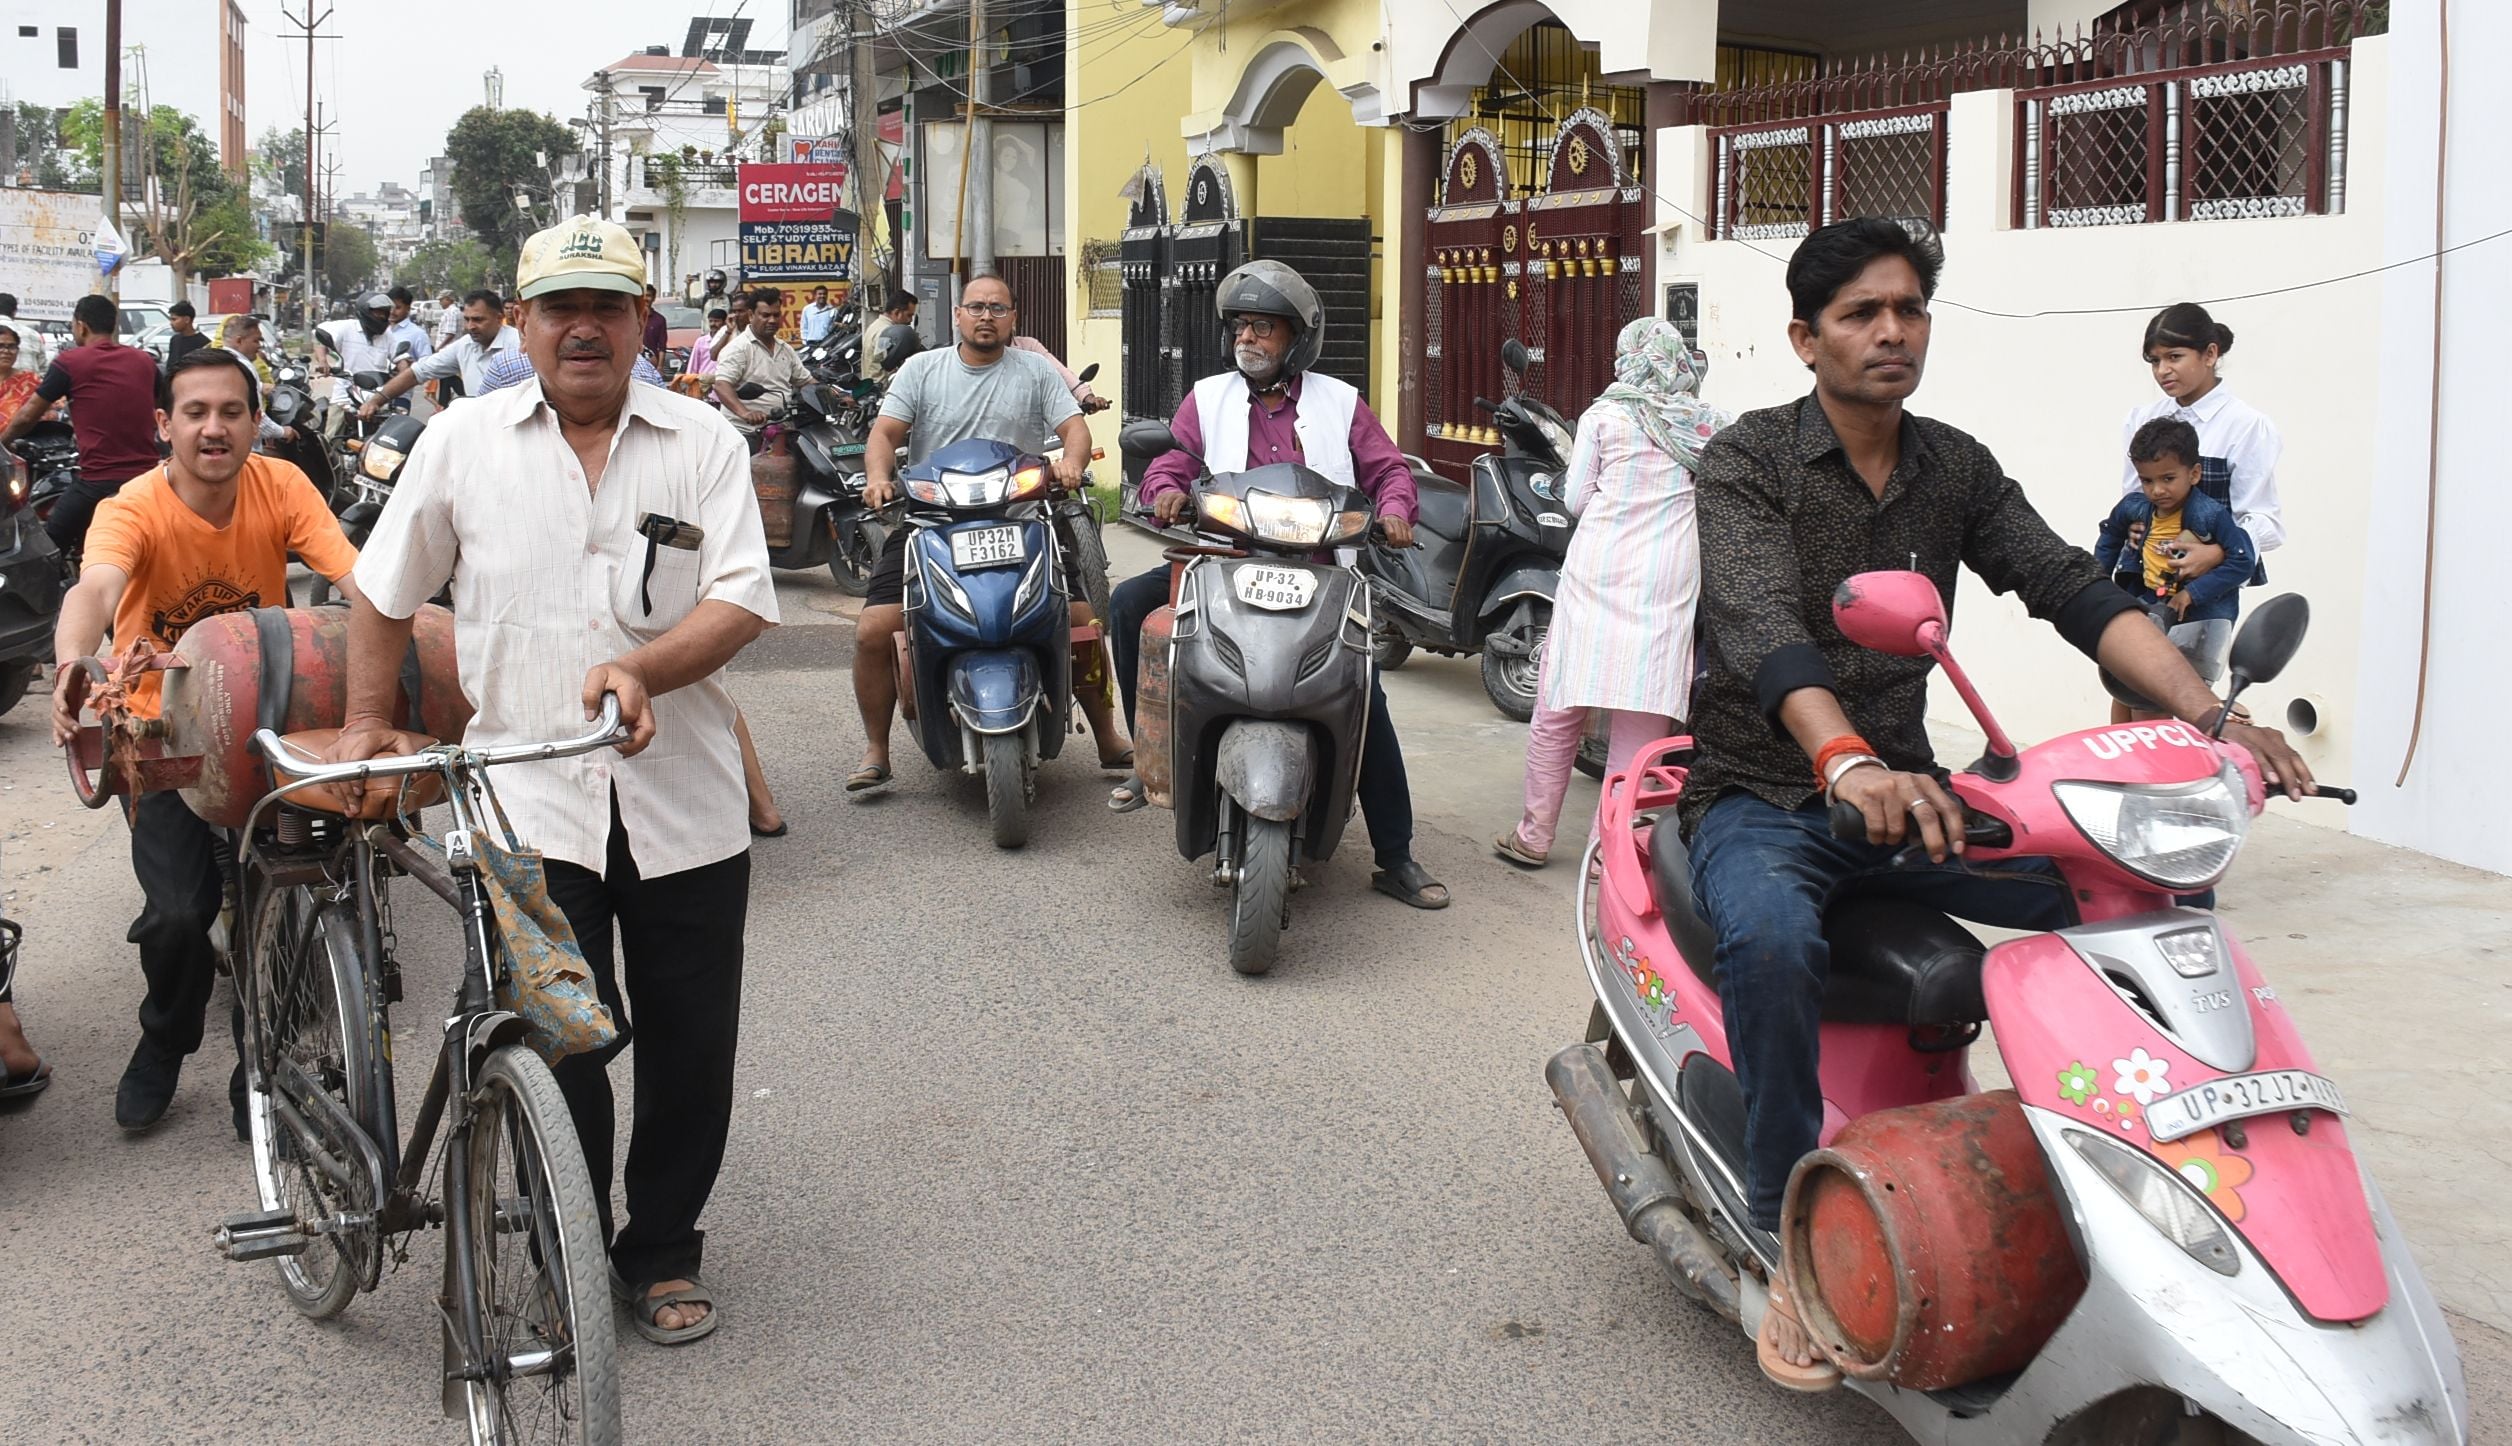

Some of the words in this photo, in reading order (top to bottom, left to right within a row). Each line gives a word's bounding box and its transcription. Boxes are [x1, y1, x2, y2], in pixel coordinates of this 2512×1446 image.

[560, 230, 603, 253] ACC
[743, 235, 768, 244] SELF
[771, 234, 806, 243] STUDY
[809, 233, 851, 243] CENTRE
[66, 247, 97, 258] AVAILA
[742, 243, 852, 265] LIBRARY
[760, 264, 784, 272] FLOOR
[785, 263, 817, 271] VINAYAK
[818, 262, 847, 271] BAZAR
[969, 542, 1017, 562] F3162
[1255, 569, 1296, 586] UP-32
[173, 586, 210, 620] WAKE
[212, 586, 234, 601] UP
[2081, 724, 2210, 760] UPPCL
[2192, 990, 2232, 1013] TVS
[2182, 1086, 2218, 1121] UP
